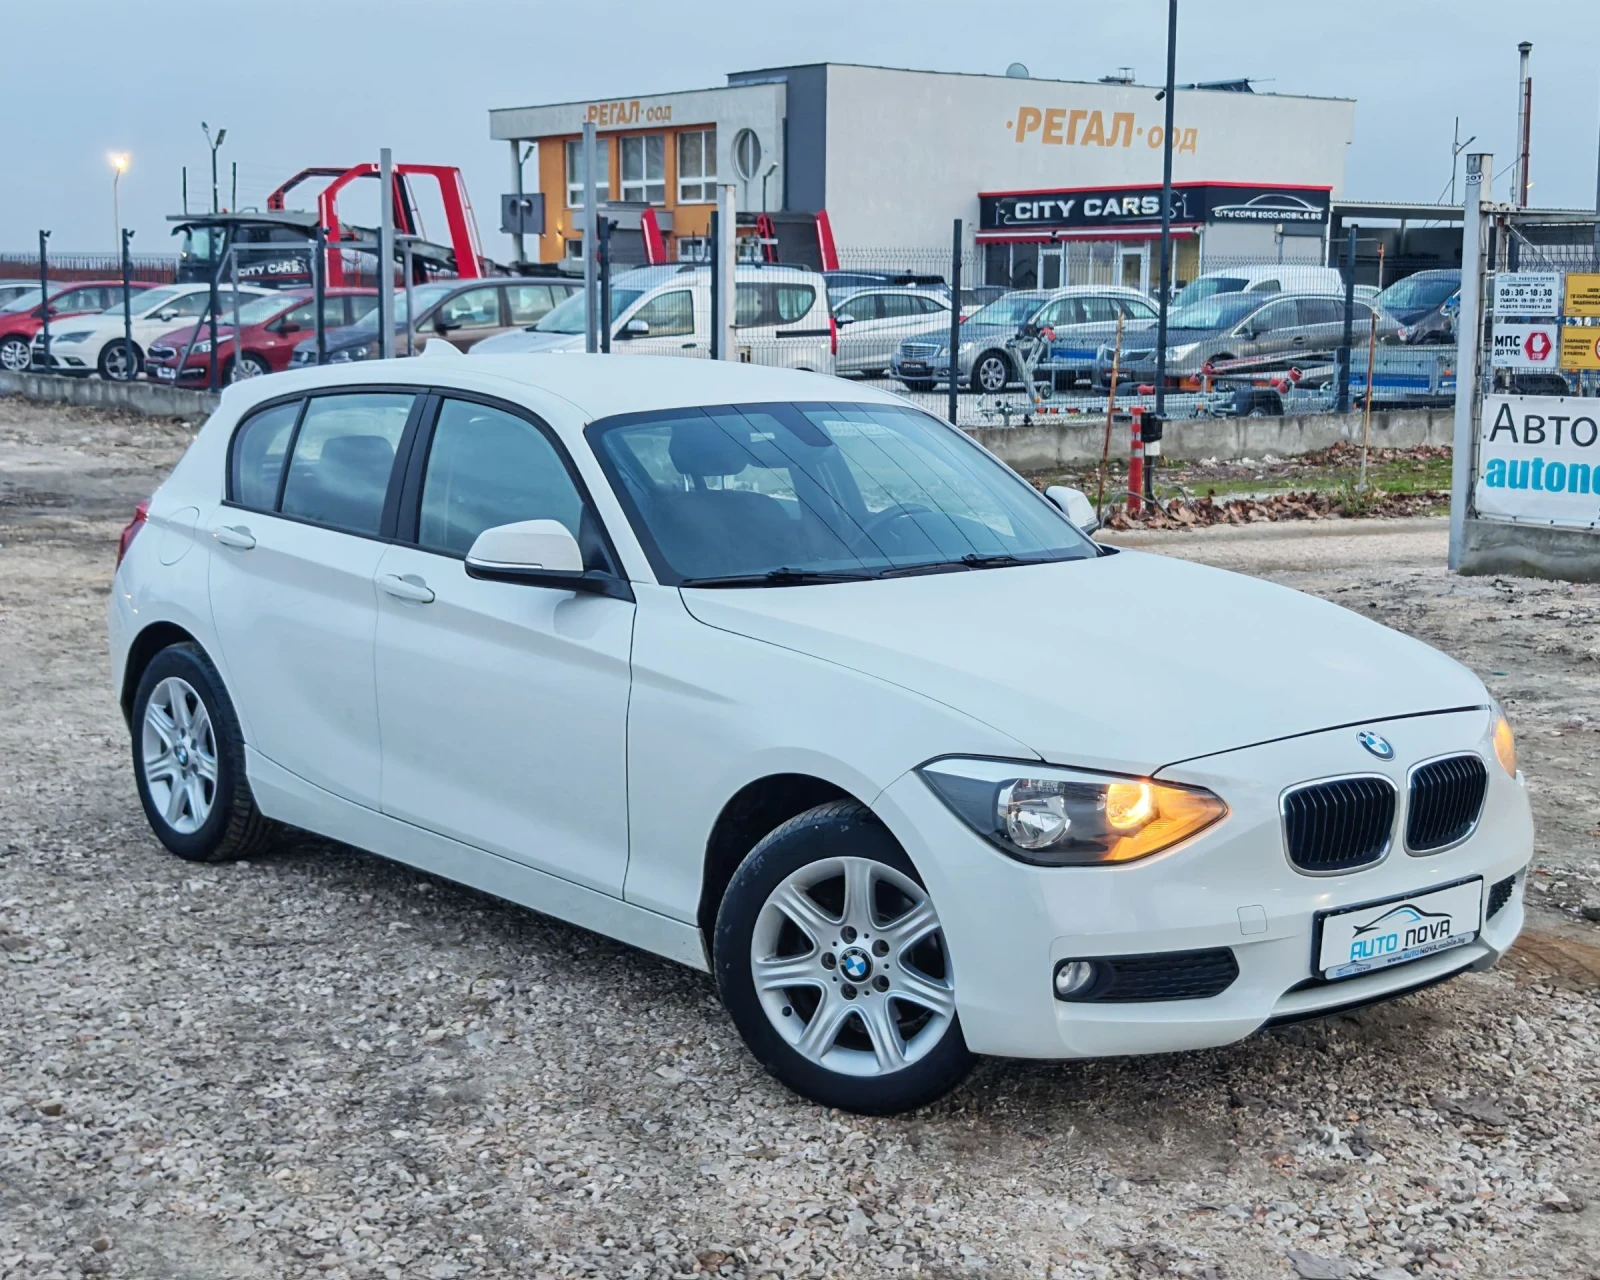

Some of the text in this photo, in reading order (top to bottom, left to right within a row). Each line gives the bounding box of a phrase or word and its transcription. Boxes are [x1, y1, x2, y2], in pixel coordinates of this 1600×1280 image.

[1015, 197, 1160, 219] CITY CARS
[238, 266, 264, 276] CITY
[1494, 336, 1521, 347] МПС
[1350, 933, 1398, 960] AUTO
